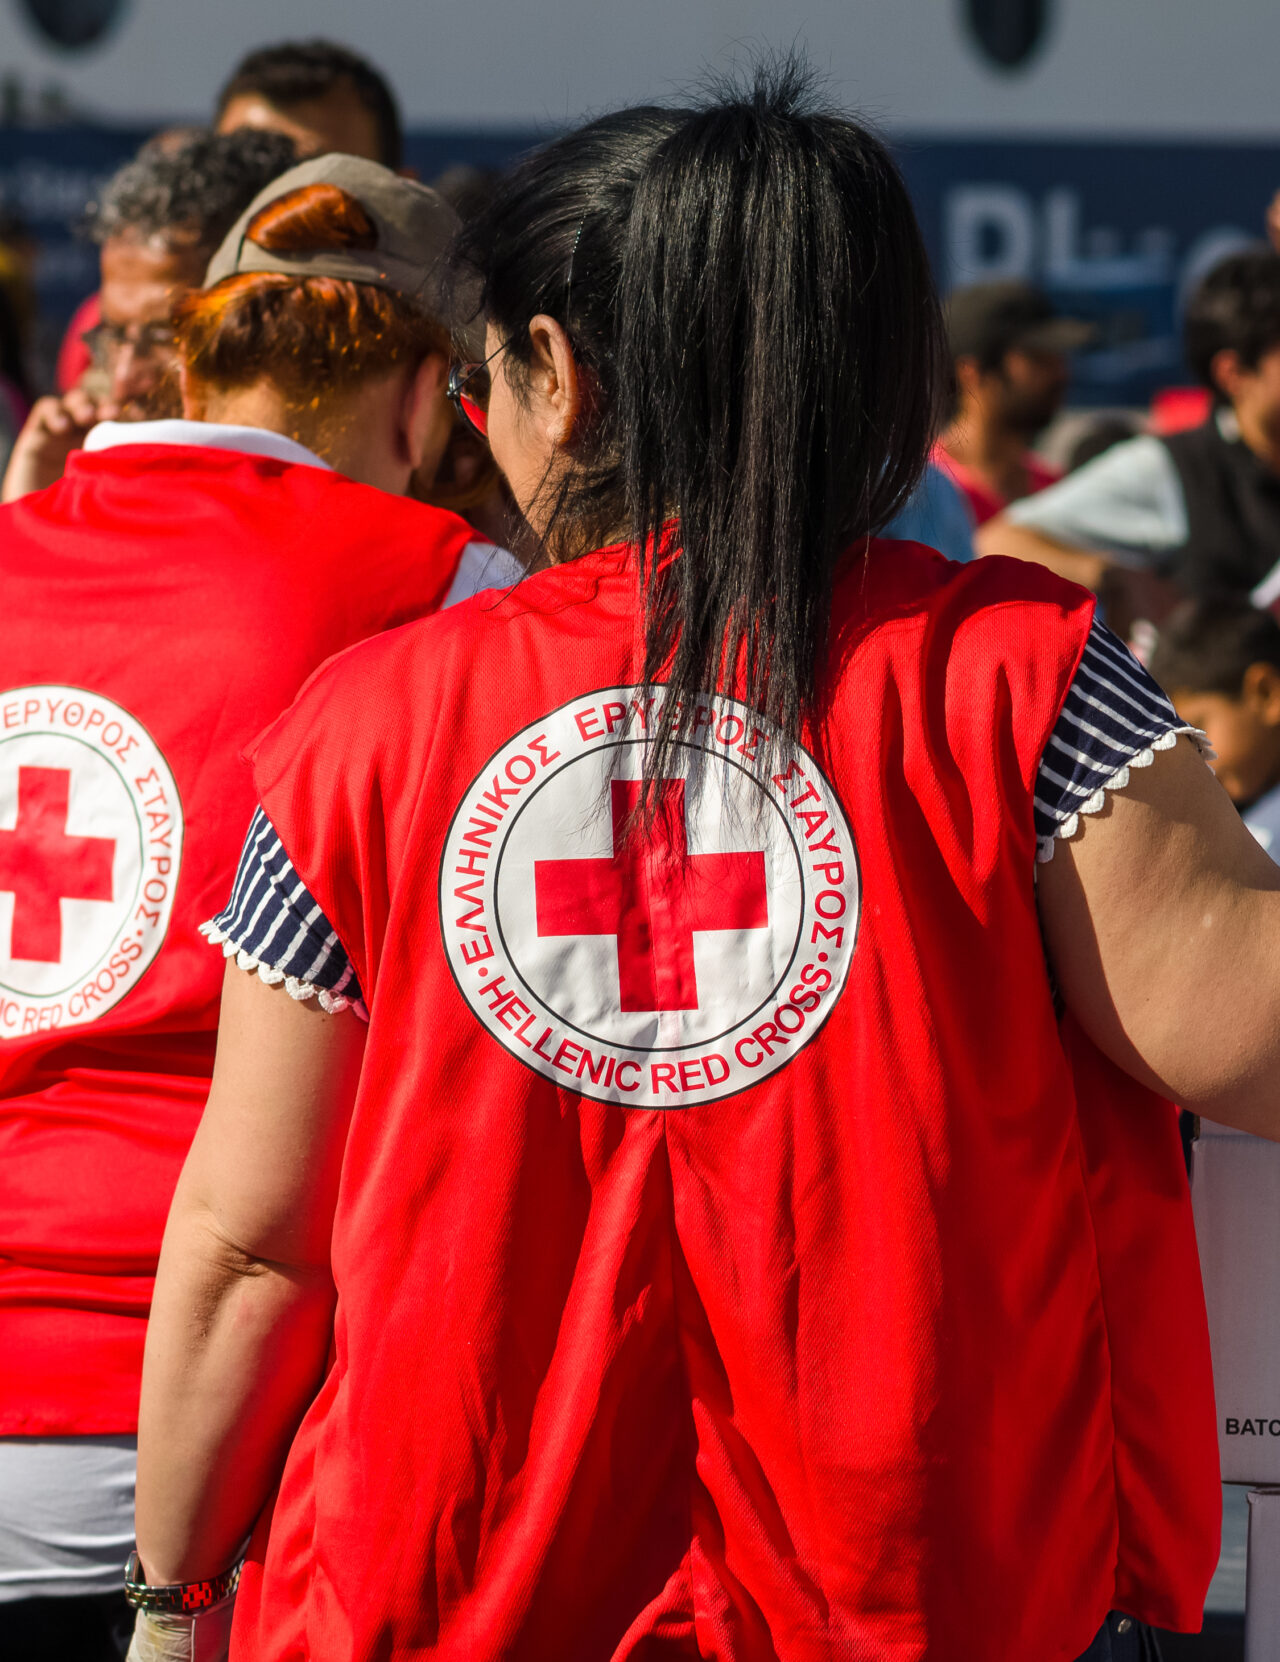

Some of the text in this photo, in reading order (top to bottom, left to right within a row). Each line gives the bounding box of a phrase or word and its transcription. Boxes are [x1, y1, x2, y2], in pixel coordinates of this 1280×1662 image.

[3, 698, 172, 929] ΕΡΥΘΡΟΣ ΣΤΑΥΡΟΣ
[454, 734, 561, 966] ΕΛΛΗΝΙΚΟΣ
[771, 759, 847, 949] ΣΤΑΥΡΟΣ
[68, 937, 143, 1018] CROSS
[477, 963, 832, 1095] HELLENIC RED CROSS
